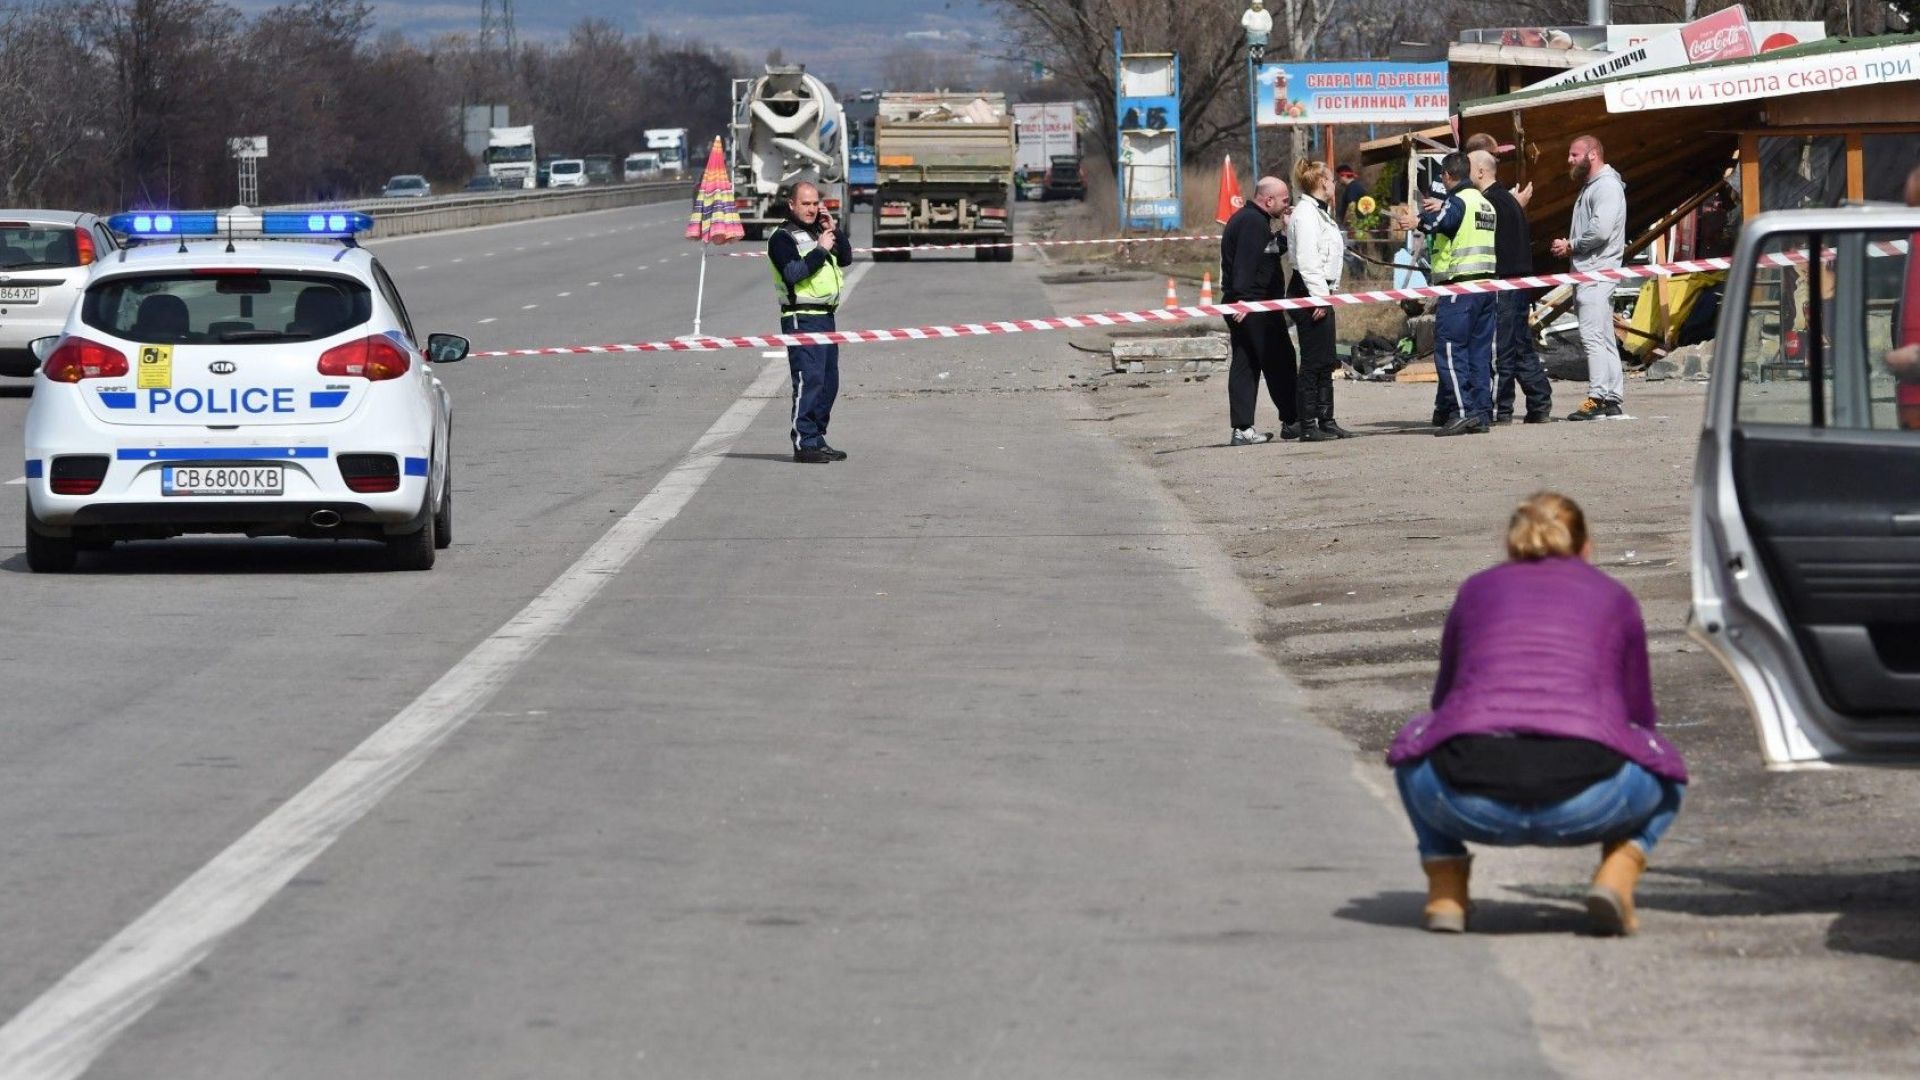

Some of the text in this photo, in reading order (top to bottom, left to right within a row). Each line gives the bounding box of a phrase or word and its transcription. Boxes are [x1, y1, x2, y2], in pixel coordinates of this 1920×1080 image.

[1308, 74, 1350, 87] СКАРА
[1356, 73, 1372, 87] НА
[1377, 72, 1441, 88] ДЪРВЕНИ
[1620, 58, 1912, 108] Супи и топла скара при
[1317, 95, 1406, 109] ГОСТИЛНИЦА
[149, 388, 295, 413] POLICE
[176, 470, 279, 487] CB 6800 KB
